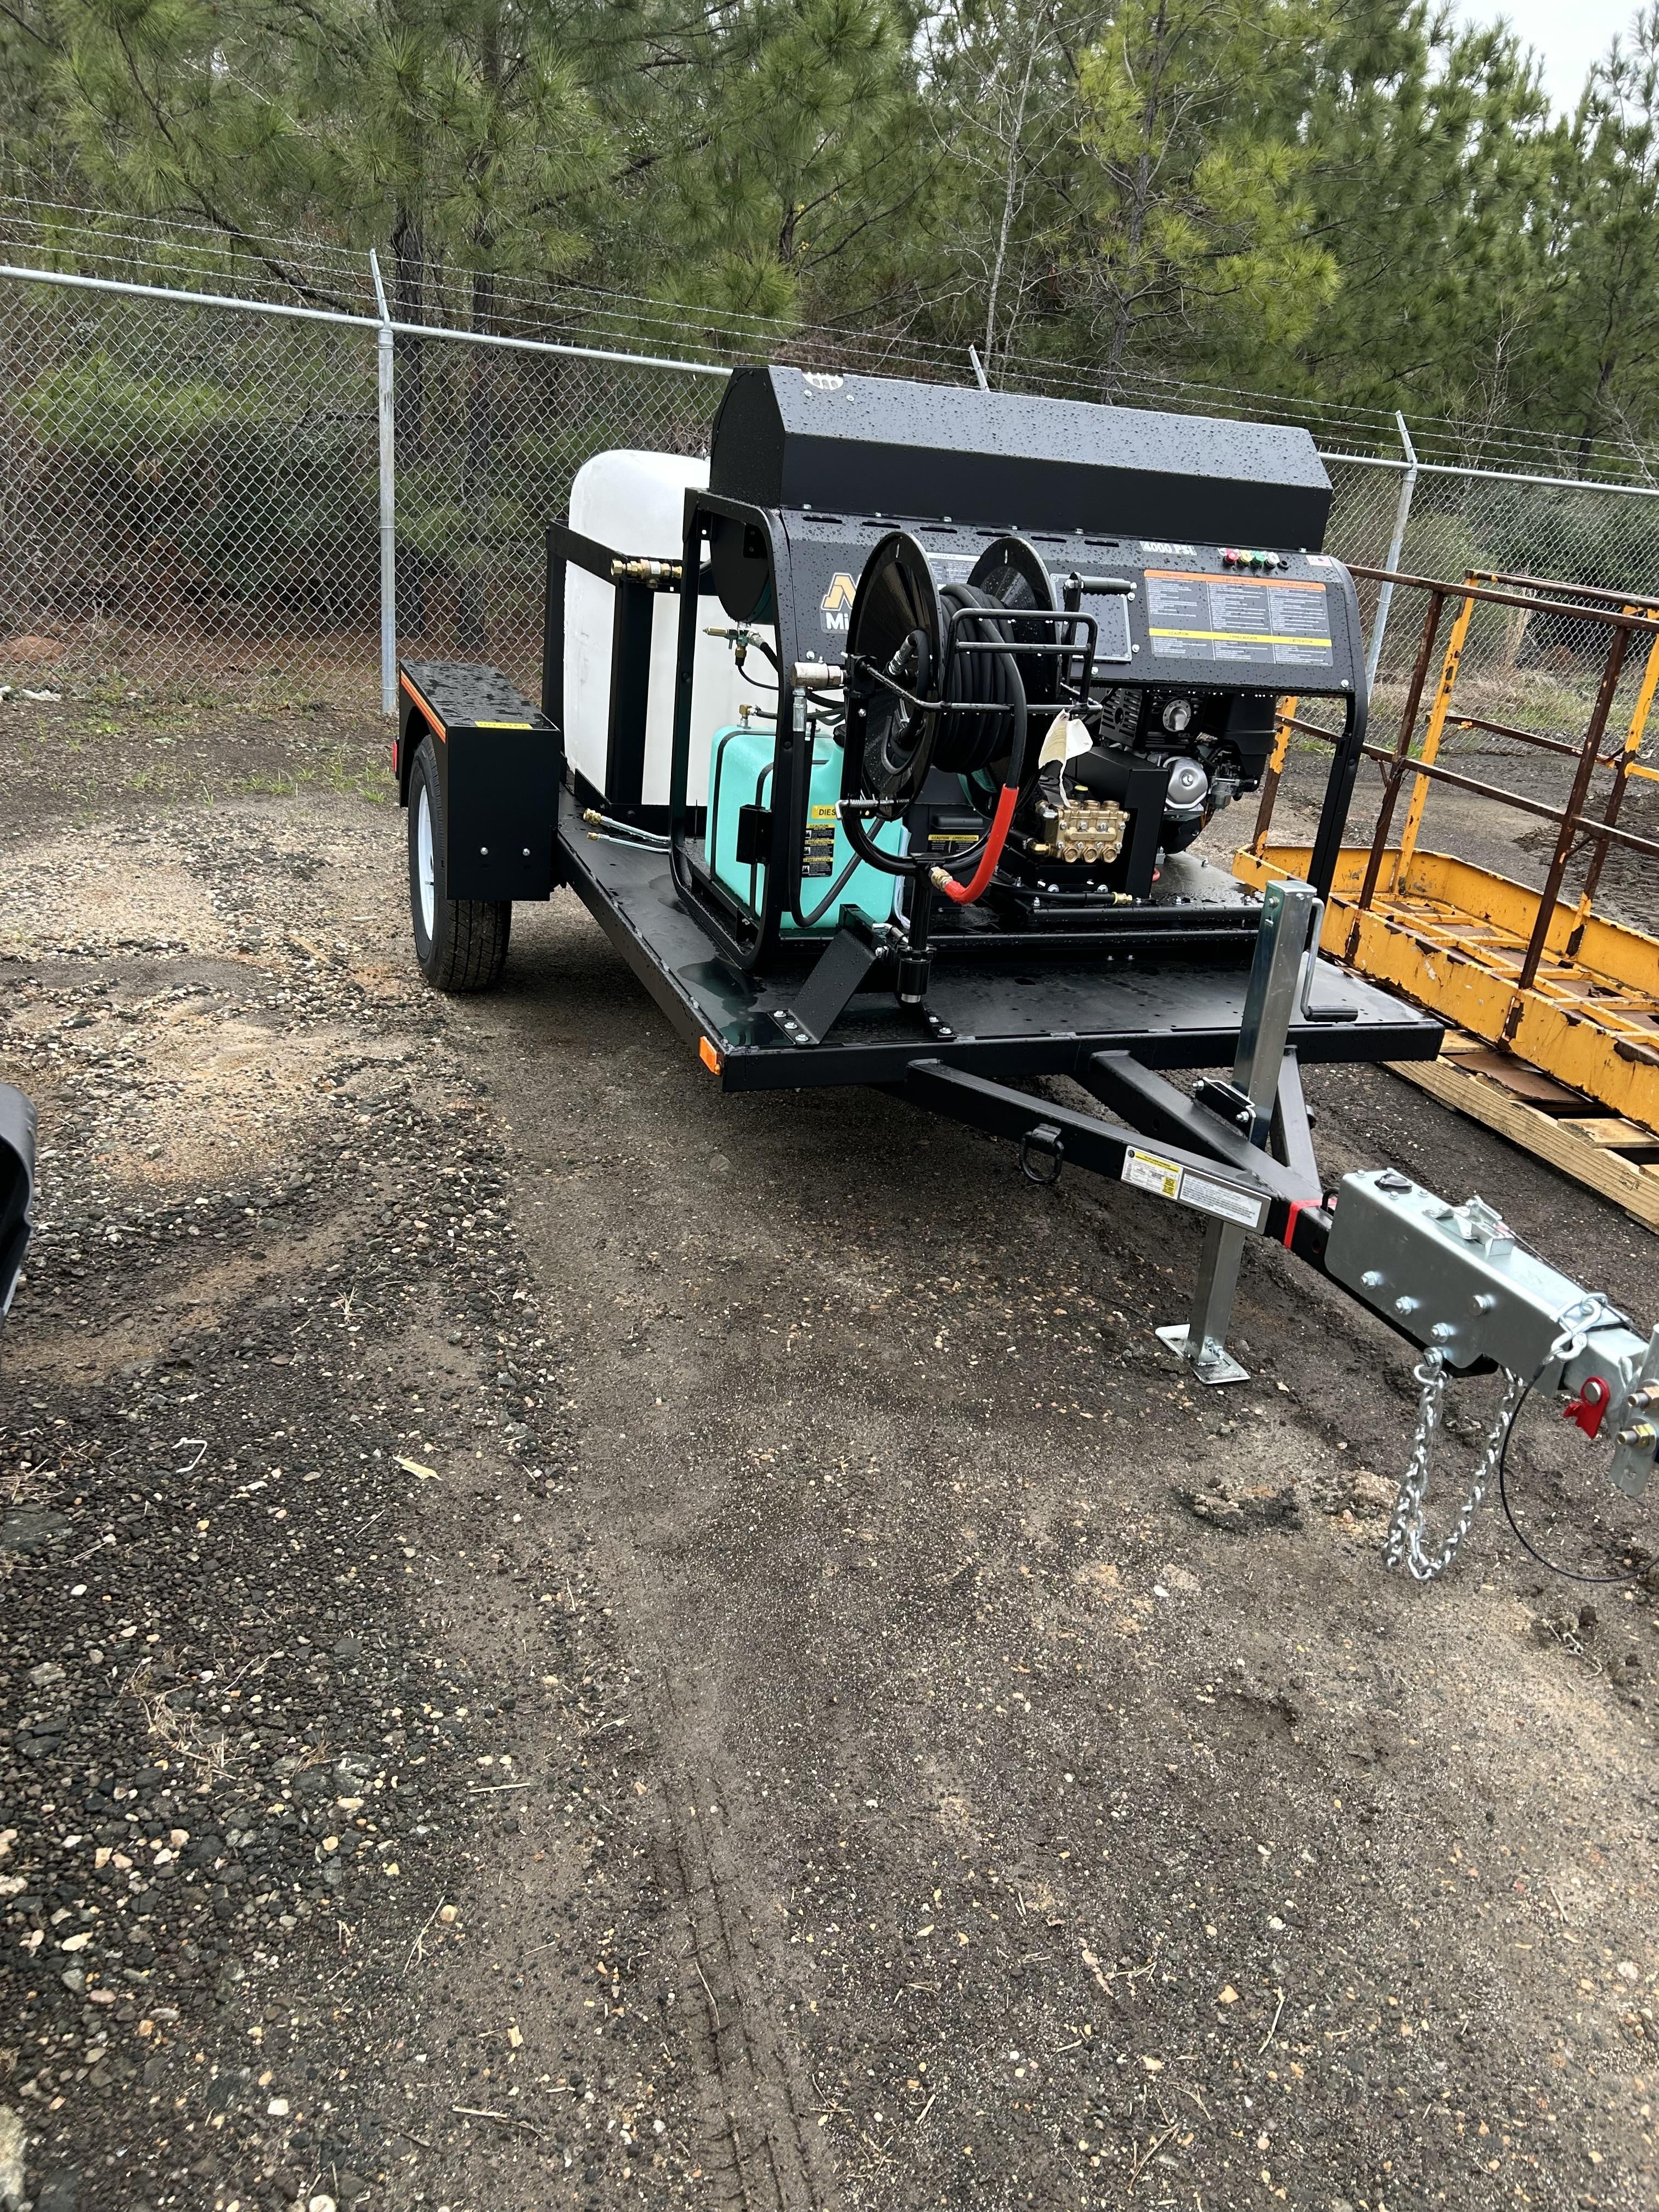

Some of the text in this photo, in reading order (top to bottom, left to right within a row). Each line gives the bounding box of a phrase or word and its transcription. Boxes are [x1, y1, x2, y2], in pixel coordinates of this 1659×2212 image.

[1143, 541, 1194, 555] 4000 PSI
[826, 612, 849, 630] Mi
